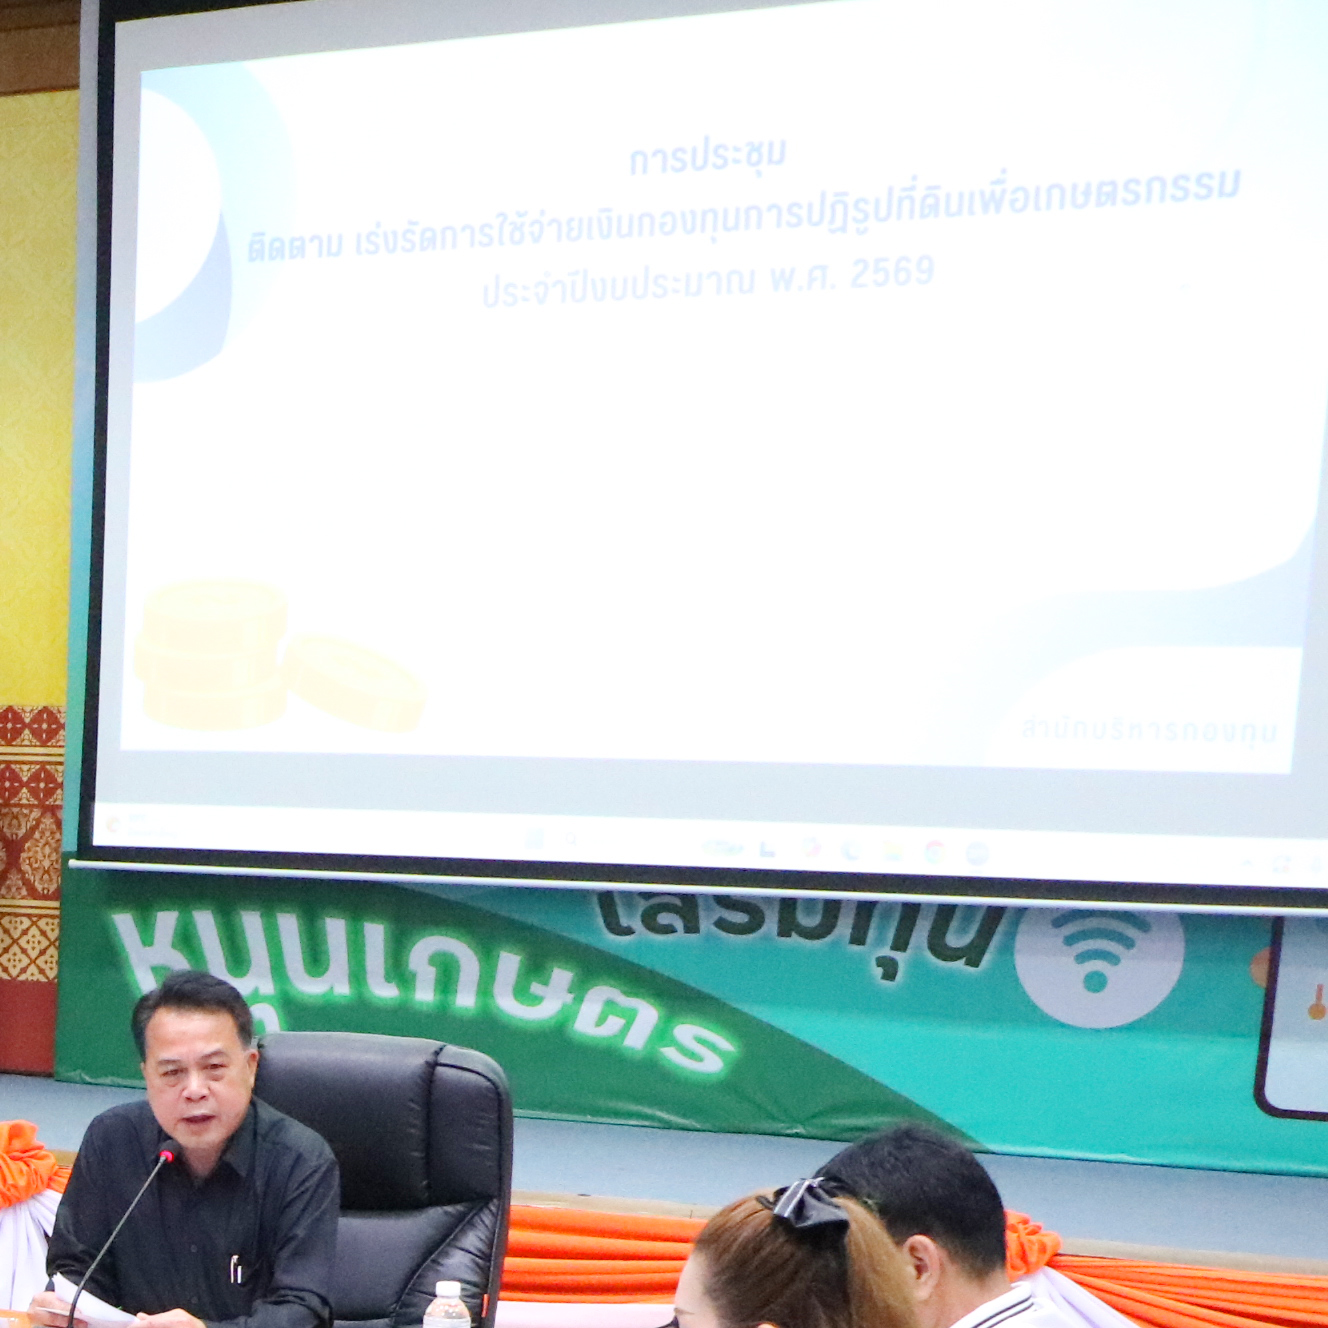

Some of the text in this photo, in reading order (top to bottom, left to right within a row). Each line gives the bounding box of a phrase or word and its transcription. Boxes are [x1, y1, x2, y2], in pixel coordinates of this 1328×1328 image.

[629, 132, 787, 180] การประชุม
[247, 228, 344, 265] ติดตาม
[482, 253, 936, 311] ประจำปีงบประมาณ พ.ศ. 2569
